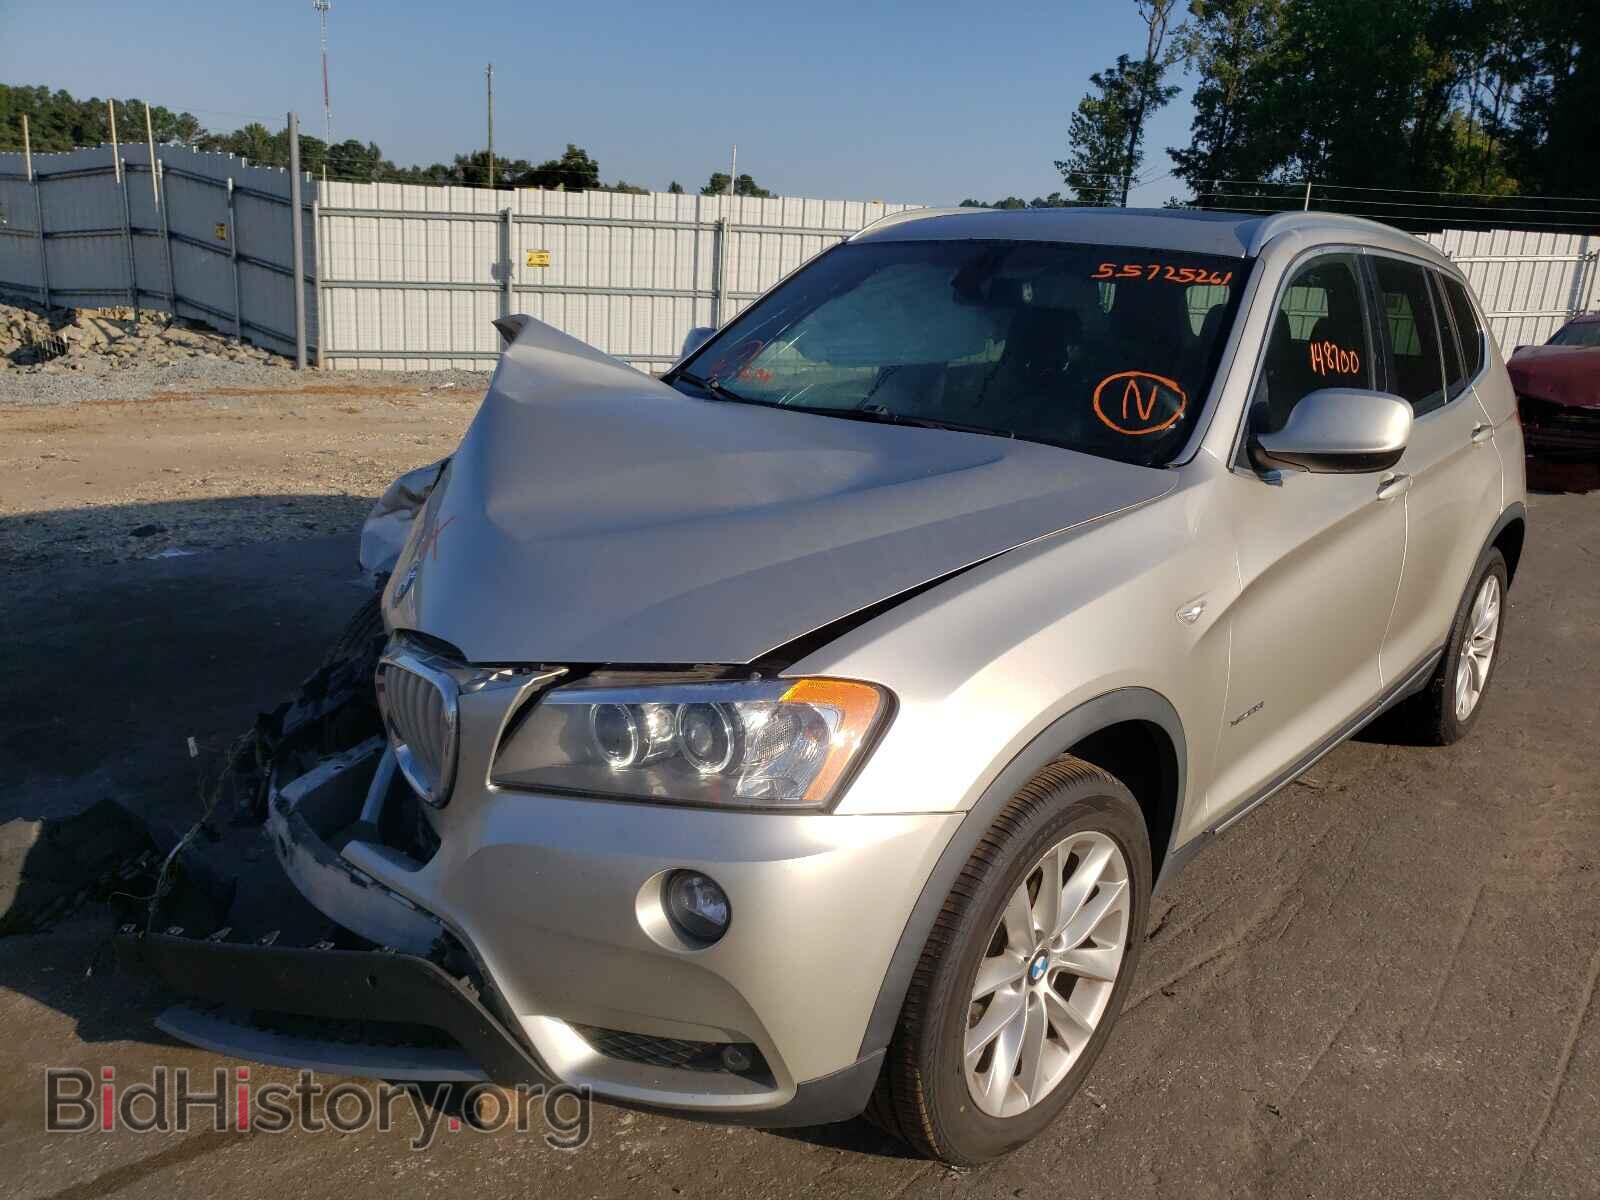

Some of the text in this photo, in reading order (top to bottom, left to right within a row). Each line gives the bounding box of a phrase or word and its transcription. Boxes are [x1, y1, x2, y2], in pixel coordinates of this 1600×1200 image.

[1091, 262, 1233, 286] 55725261
[1310, 340, 1360, 377] 148700
[1122, 379, 1158, 421] N
